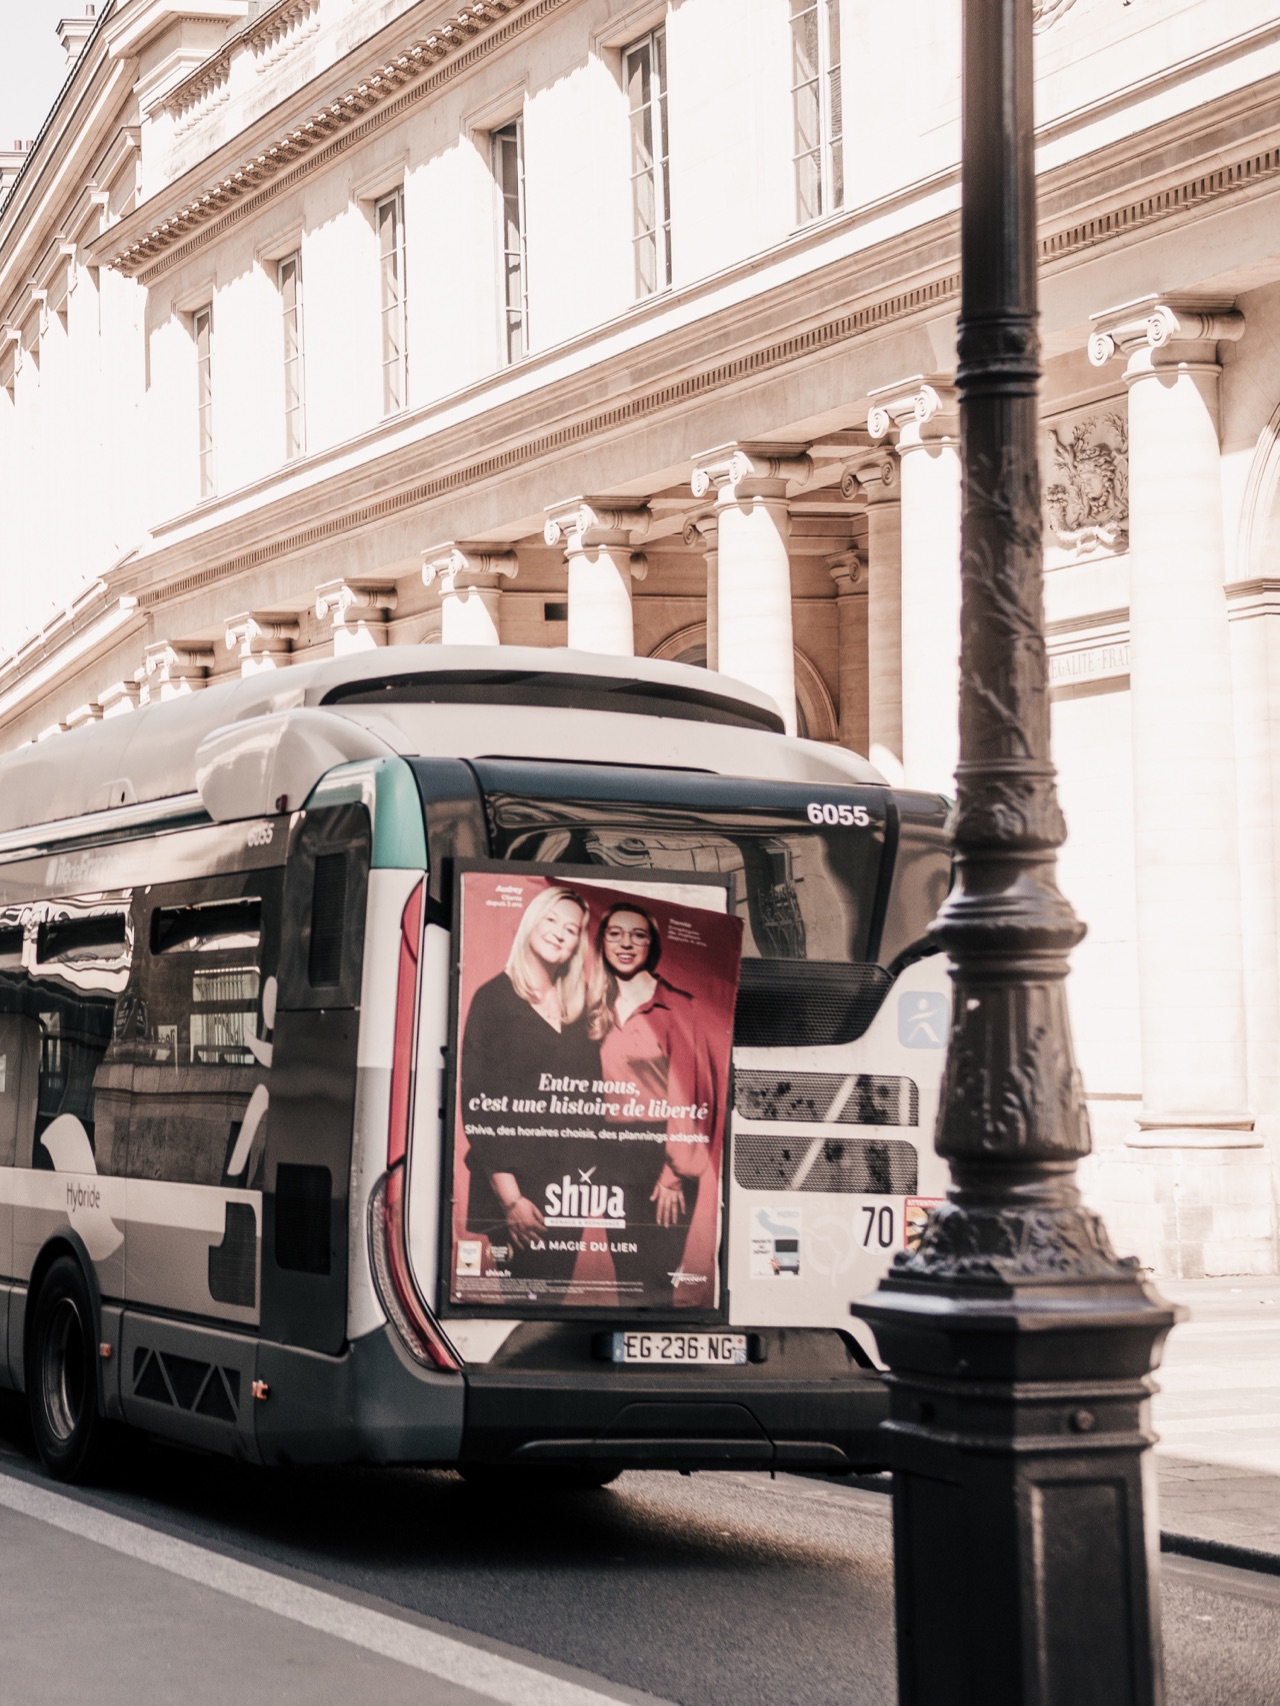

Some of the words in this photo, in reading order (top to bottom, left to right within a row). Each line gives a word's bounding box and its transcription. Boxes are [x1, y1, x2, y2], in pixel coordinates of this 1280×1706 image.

[807, 802, 870, 827] 6055
[538, 1073, 590, 1093] Entre
[592, 1078, 641, 1098] nous,
[512, 1098, 547, 1114] une
[549, 1095, 620, 1117] histoire
[622, 1099, 645, 1118] de
[647, 1099, 709, 1120] liberté
[464, 1123, 496, 1137] Shiva,
[496, 1125, 516, 1137] des
[517, 1125, 560, 1138] horaires
[560, 1127, 597, 1140] choisis,
[598, 1128, 618, 1140] des
[618, 1129, 668, 1144] plannings
[669, 1132, 710, 1144] adaptés
[66, 1182, 100, 1213] Hybride
[544, 1170, 626, 1218] shiva
[862, 1206, 894, 1248] 70
[530, 1239, 546, 1251] LA
[548, 1240, 587, 1252] MAGIE
[589, 1241, 608, 1252] DU
[610, 1242, 638, 1253] LIEN
